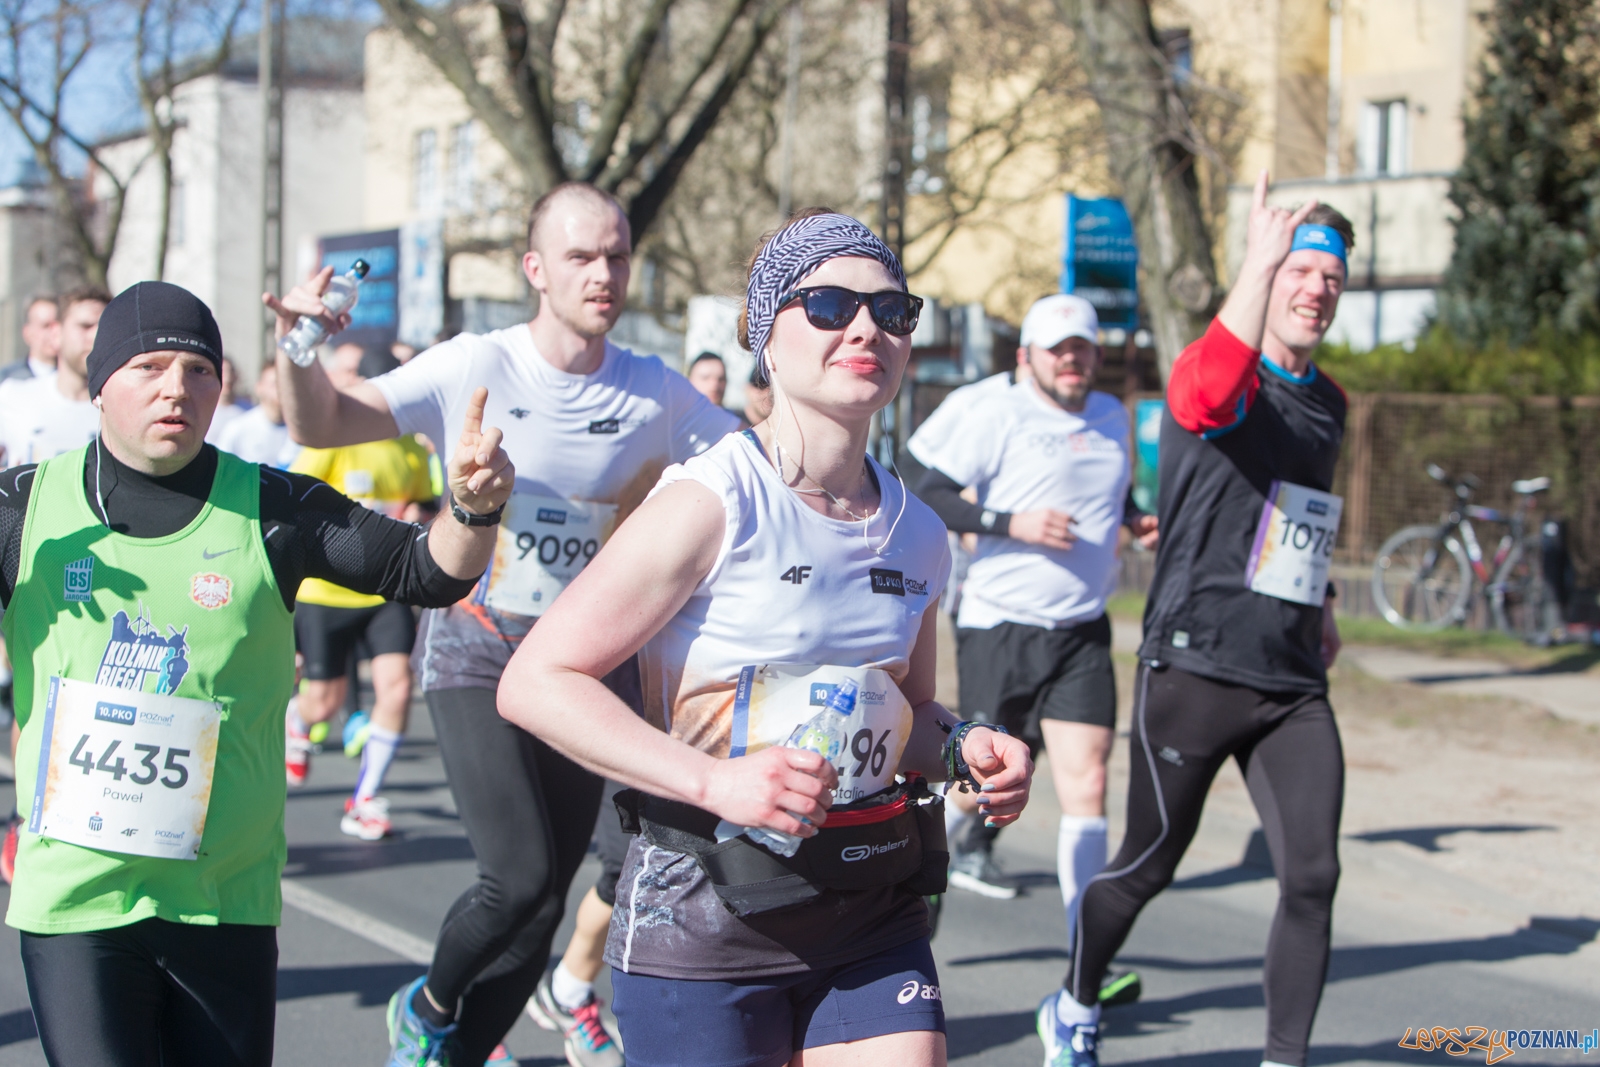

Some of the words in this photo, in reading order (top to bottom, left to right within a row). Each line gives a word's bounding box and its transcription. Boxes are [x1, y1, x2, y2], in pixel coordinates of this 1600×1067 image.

[516, 530, 598, 569] 9099
[69, 571, 87, 588] BS
[780, 565, 812, 585] 4F
[65, 593, 90, 601] JAROCIN
[68, 733, 191, 789] 4435
[102, 786, 144, 804] Paweł
[831, 785, 866, 800] atalia
[120, 827, 139, 837] 4F
[871, 834, 909, 856] Kalenji
